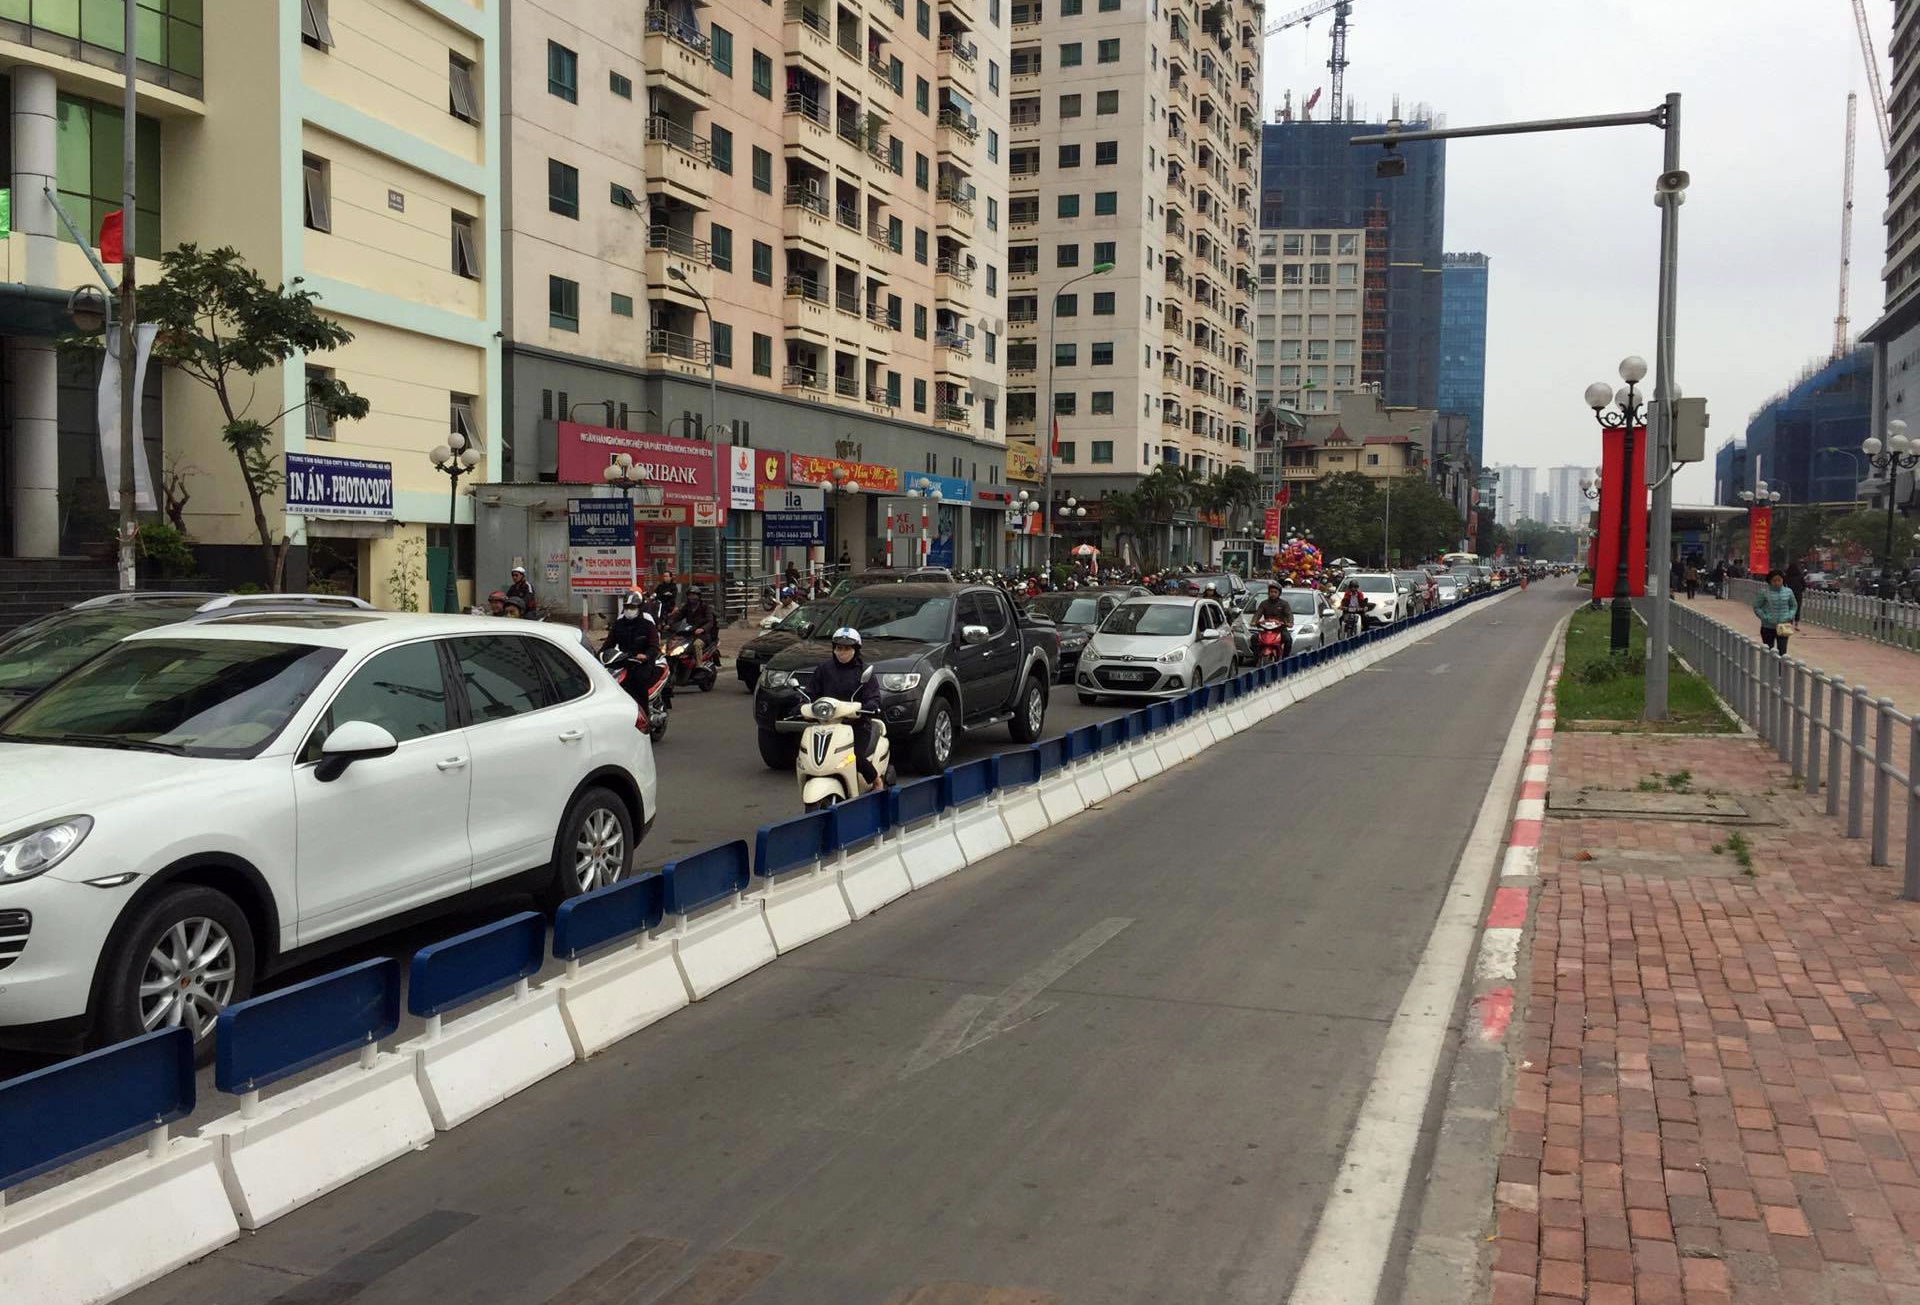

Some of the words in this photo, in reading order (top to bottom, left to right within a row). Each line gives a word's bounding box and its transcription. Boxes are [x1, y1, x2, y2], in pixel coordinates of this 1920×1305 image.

[288, 455, 304, 463] TRUNG
[304, 456, 313, 464] TÂM
[290, 471, 304, 500] IN
[307, 466, 324, 501] ẤN
[332, 476, 391, 505] PHOTOCOPY
[785, 490, 802, 507] ila
[569, 513, 600, 526] THANH
[603, 510, 629, 526] CHÂN
[896, 513, 910, 523] XE
